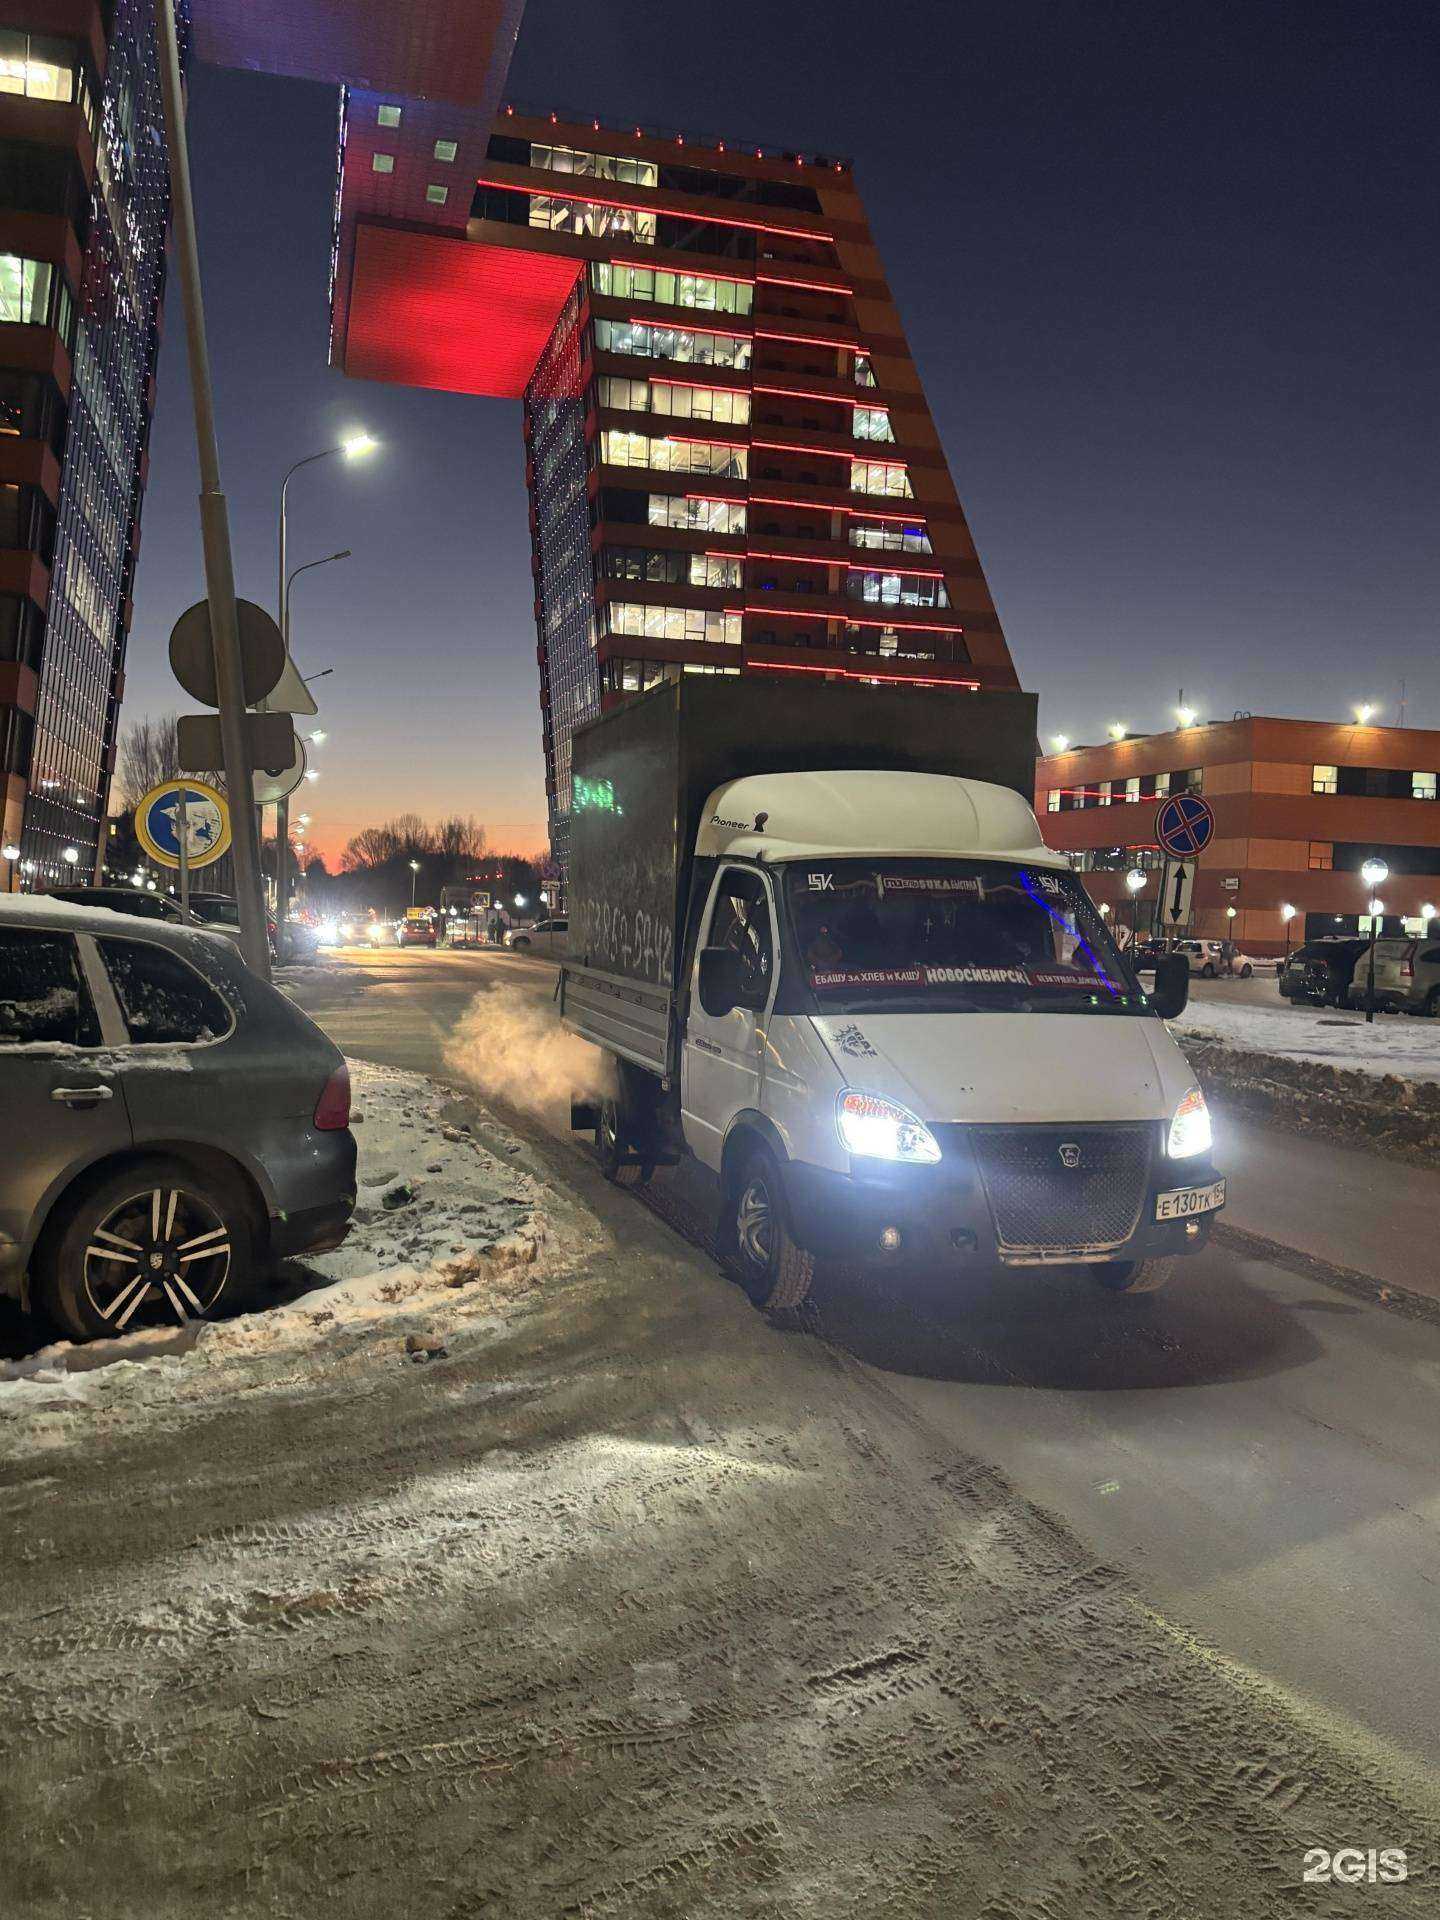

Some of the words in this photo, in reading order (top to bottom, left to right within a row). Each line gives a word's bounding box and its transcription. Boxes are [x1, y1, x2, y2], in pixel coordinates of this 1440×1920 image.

[710, 815, 749, 830] Pioneer
[815, 973, 846, 985] ЕБАШУ
[861, 972, 885, 982] ХЛЕБ
[894, 970, 920, 981] КАШУ
[926, 967, 1026, 984] НОВОСИБИРСК
